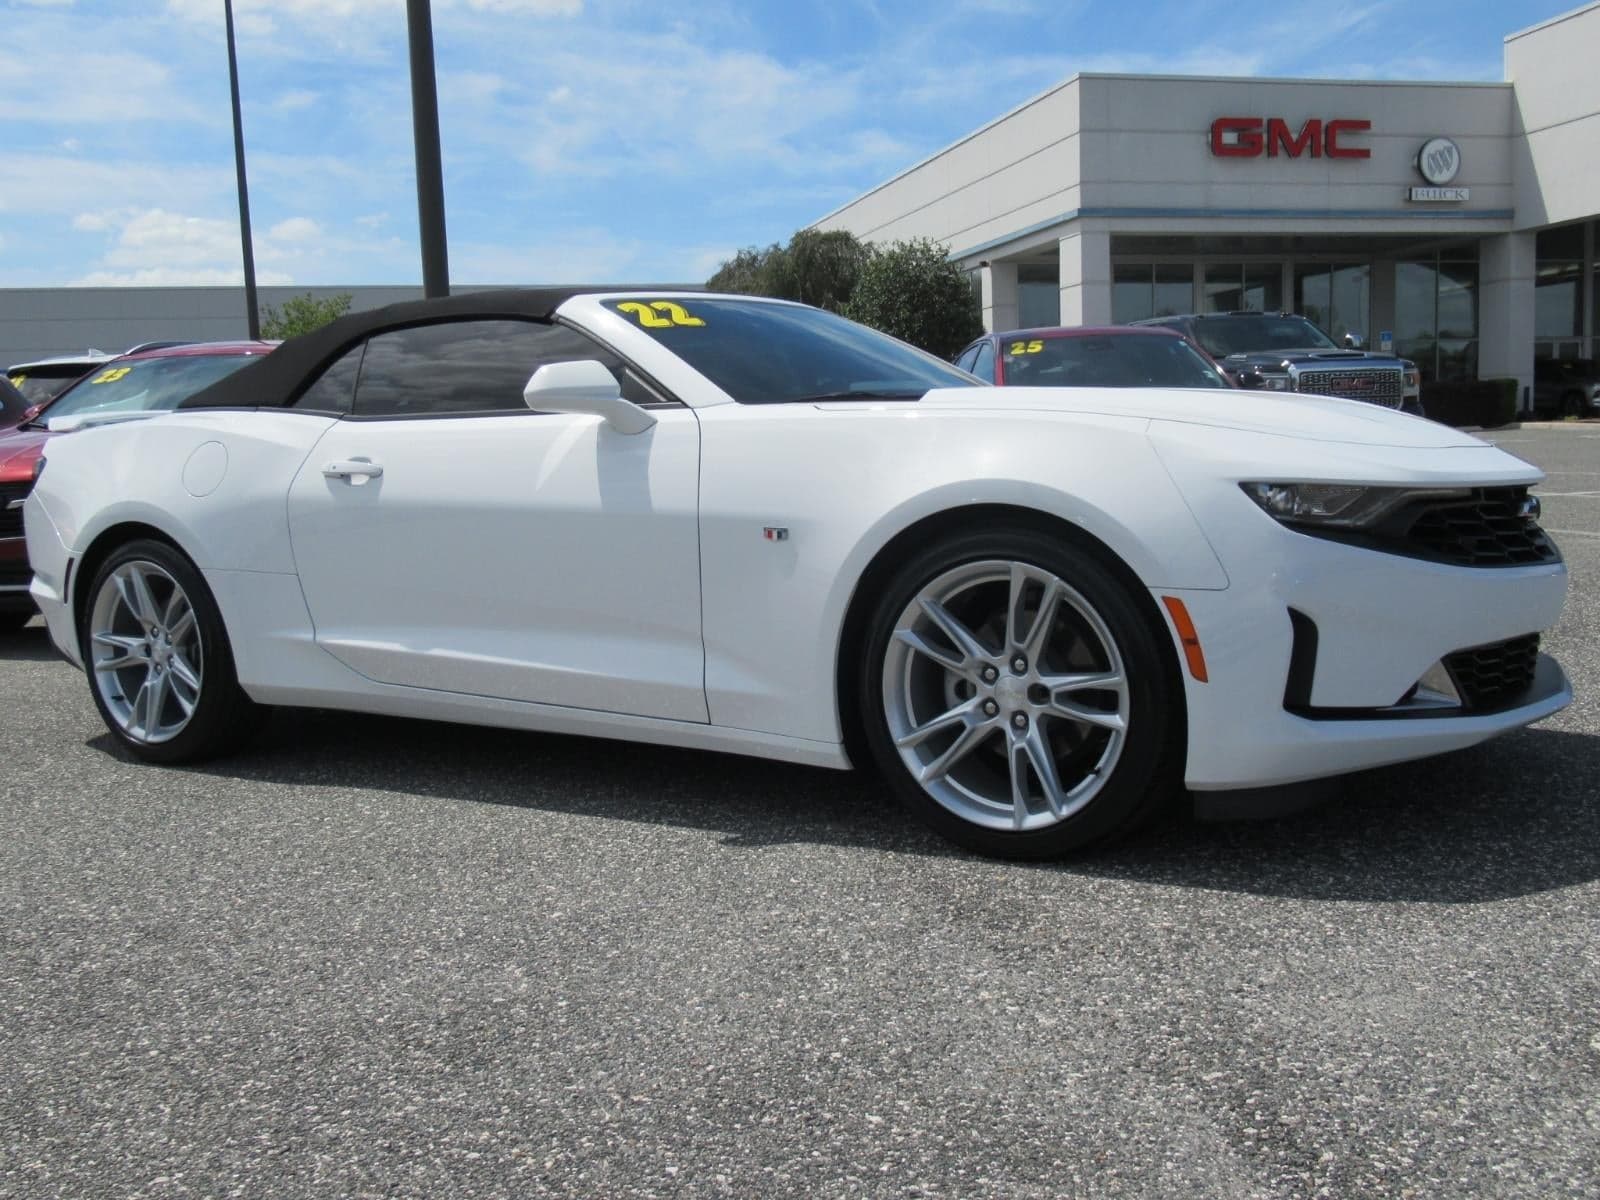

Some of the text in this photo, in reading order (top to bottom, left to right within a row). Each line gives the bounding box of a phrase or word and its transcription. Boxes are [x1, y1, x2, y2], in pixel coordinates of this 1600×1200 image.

[1211, 117, 1371, 159] GMC
[1413, 189, 1466, 200] BUICK
[616, 302, 706, 328] 22
[1010, 341, 1044, 355] 25
